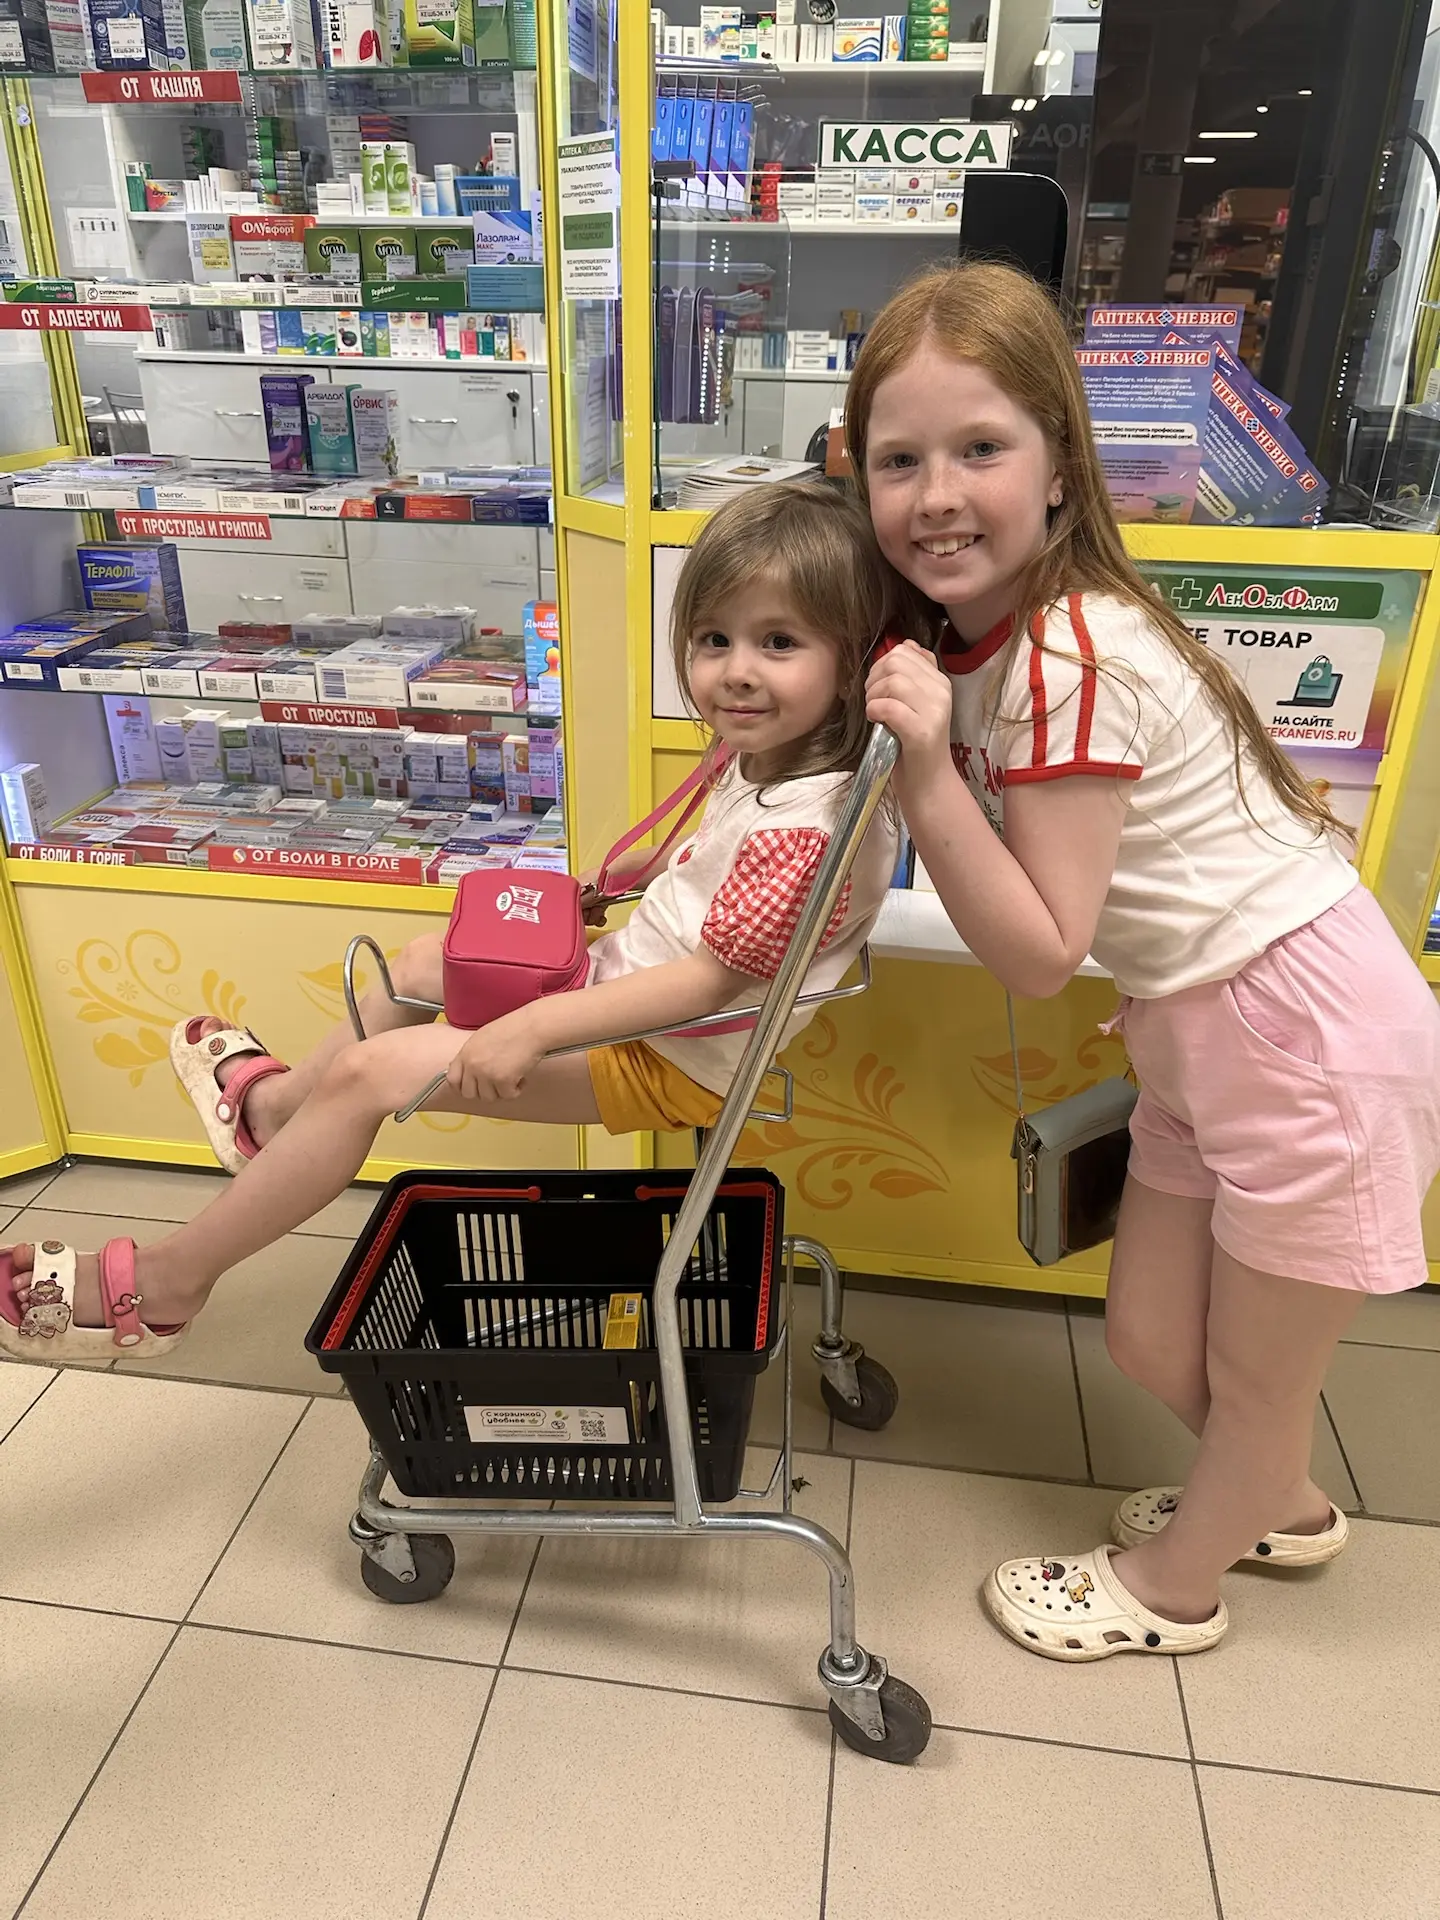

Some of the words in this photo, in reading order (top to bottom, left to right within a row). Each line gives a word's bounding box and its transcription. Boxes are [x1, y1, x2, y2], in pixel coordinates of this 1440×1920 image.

[120, 77, 140, 98] ОТ
[150, 76, 203, 98] КАШЛЯ
[560, 146, 582, 157] АПТЕКА
[832, 127, 998, 164] КАССА
[896, 198, 931, 206] ФЕРВЕКС
[476, 233, 520, 243] Лазолван
[21, 309, 41, 327] ОТ
[48, 309, 123, 328] АЛЛЕРГИИ
[1095, 312, 1156, 325] АПТЕКА
[1175, 312, 1234, 325] НЕВИС
[1076, 351, 1130, 364] ПТЕКА
[1150, 351, 1208, 364] НЕВИС
[306, 392, 345, 401] АРБИДОЛ
[1210, 372, 1248, 422] ПТЕКА
[1255, 429, 1298, 477] НЕВИС
[122, 517, 137, 533] ОТ
[143, 517, 206, 538] ПРОСТУДЫ
[208, 521, 217, 536] И
[220, 521, 268, 538] ГРИППА
[1223, 628, 1313, 649] ТОВАР
[282, 706, 299, 720] ОТ
[308, 707, 378, 727] ПРОСТУДЫ
[1272, 715, 1291, 726] НА
[1292, 715, 1334, 728] САЙТЕ
[20, 847, 34, 859] ОТ
[41, 849, 71, 862] БОЛИ
[77, 851, 84, 863] В
[90, 852, 126, 865] ГОРЛЕ
[252, 850, 274, 862] ОТ
[280, 852, 325, 866] БОЛИ
[331, 856, 341, 866] В
[347, 856, 400, 870] ГОРЛЕ
